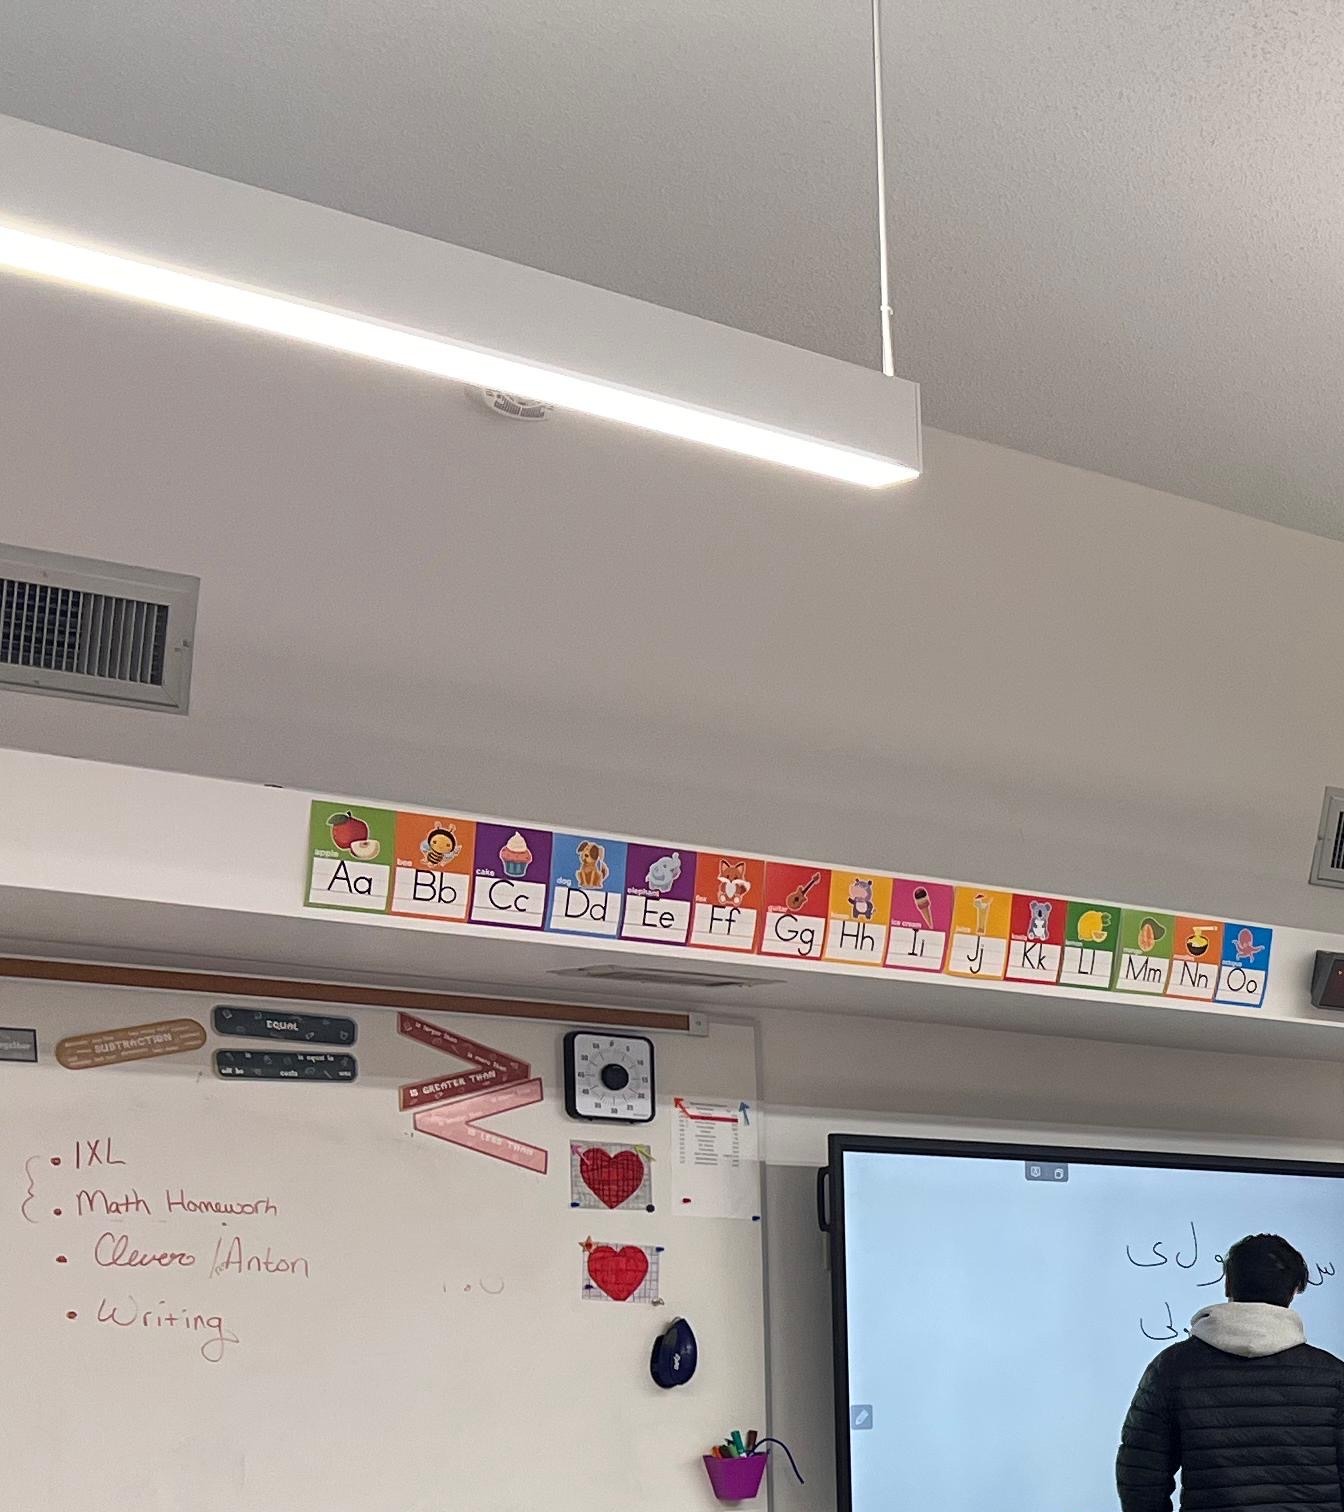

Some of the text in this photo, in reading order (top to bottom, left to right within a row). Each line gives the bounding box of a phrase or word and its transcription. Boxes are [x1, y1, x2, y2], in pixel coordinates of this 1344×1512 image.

[328, 860, 372, 895] Aa
[412, 868, 457, 904] Bb
[489, 879, 530, 912] Cc
[565, 888, 607, 922] Dd
[642, 897, 675, 928] Ee
[709, 905, 741, 935] Ff
[774, 913, 815, 956] Gg
[839, 920, 875, 951] Hh
[908, 928, 925, 957] Ii
[966, 935, 984, 975] Jj
[1022, 941, 1046, 970] Kk
[1078, 948, 1096, 975] Ll
[1126, 955, 1162, 983] Mm
[1180, 961, 1208, 989] Nn
[1227, 967, 1258, 994] Oo
[266, 1020, 299, 1031] EQUAL
[94, 1033, 173, 1054] SUBTRACTION
[409, 1070, 496, 1098] IS GREATER THAN
[75, 1137, 126, 1169] IXL
[77, 1188, 277, 1216] Math Homework
[97, 1295, 240, 1362] Writing
